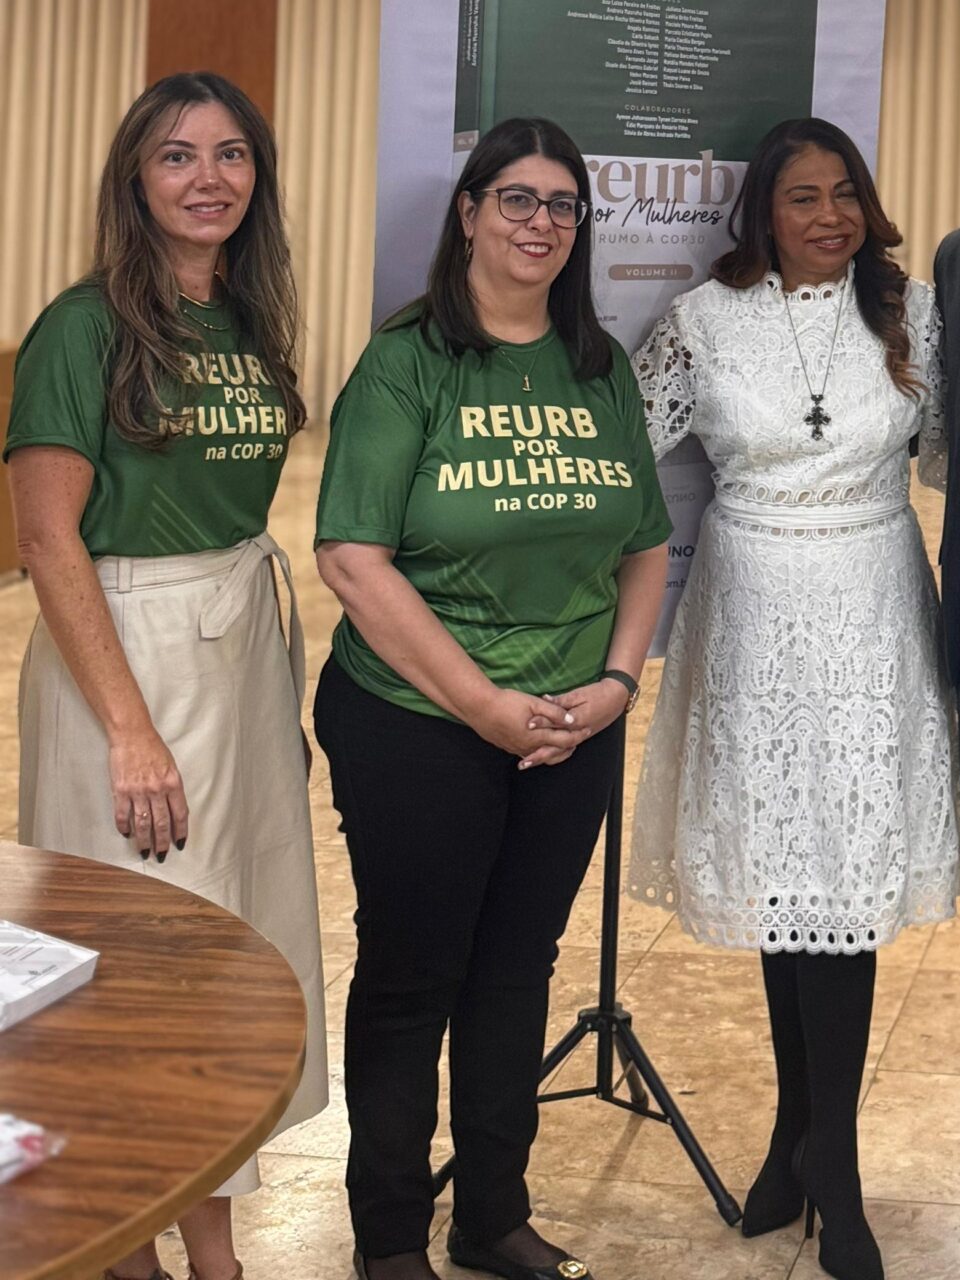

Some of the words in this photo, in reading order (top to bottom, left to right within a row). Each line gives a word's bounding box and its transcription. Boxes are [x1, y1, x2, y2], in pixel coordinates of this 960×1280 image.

[594, 207, 615, 223] or
[621, 196, 724, 228] Mulheres
[599, 233, 640, 244] RUMO
[646, 231, 654, 244] À
[660, 234, 705, 244] COP30
[625, 268, 667, 276] VOLUME
[178, 352, 272, 386] REUR
[224, 386, 264, 404] POR
[159, 406, 287, 437] MULHER
[460, 405, 598, 439] REURB
[205, 446, 226, 460] na
[231, 443, 264, 460] COP
[267, 443, 283, 460] 30
[512, 439, 563, 456] POR
[437, 457, 633, 492] MULHERES
[494, 496, 521, 512] na
[526, 493, 568, 510] COP
[574, 492, 597, 510] 30
